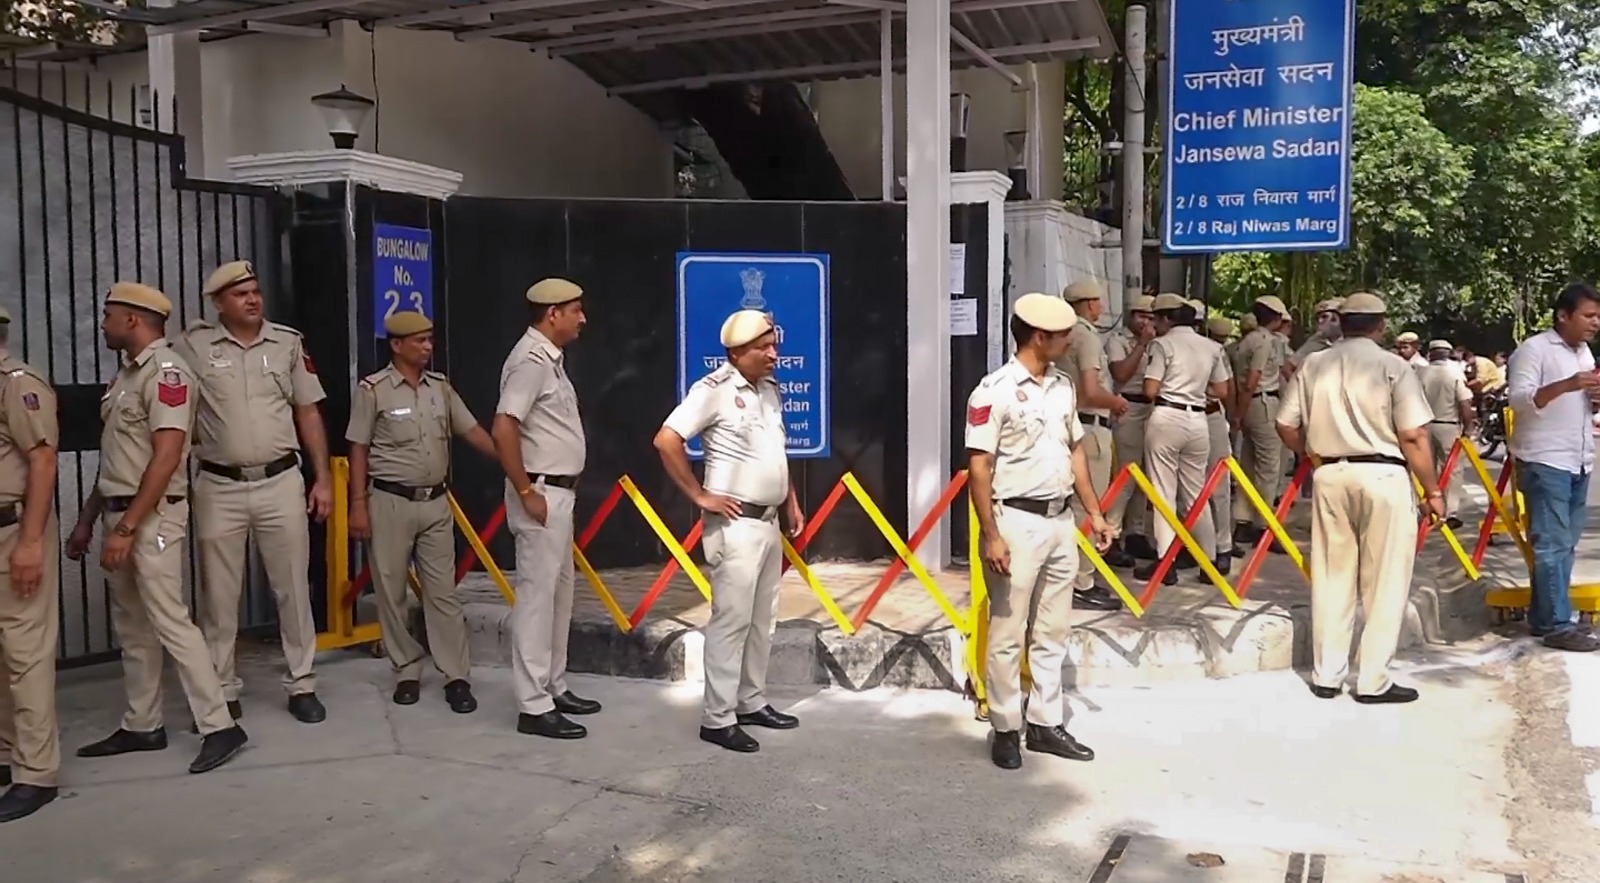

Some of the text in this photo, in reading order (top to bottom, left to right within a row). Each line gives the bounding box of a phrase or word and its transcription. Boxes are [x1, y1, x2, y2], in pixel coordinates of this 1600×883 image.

[1211, 15, 1305, 56] मुख्यमंत्री
[1183, 62, 1334, 91] जनसेवा सदन
[1173, 104, 1343, 132] Chief Minister
[1174, 137, 1340, 164] Jansewa Sadan
[1216, 193, 1245, 207] राज
[1253, 188, 1299, 206] निवास
[1307, 184, 1337, 203] मार्ग
[1211, 220, 1237, 236] Raj
[1242, 218, 1291, 233] Niwas
[1295, 217, 1337, 234] Marg
[377, 237, 429, 261] BUNGALOW
[394, 265, 414, 286] No.
[780, 381, 811, 394] ster
[780, 398, 810, 413] dan
